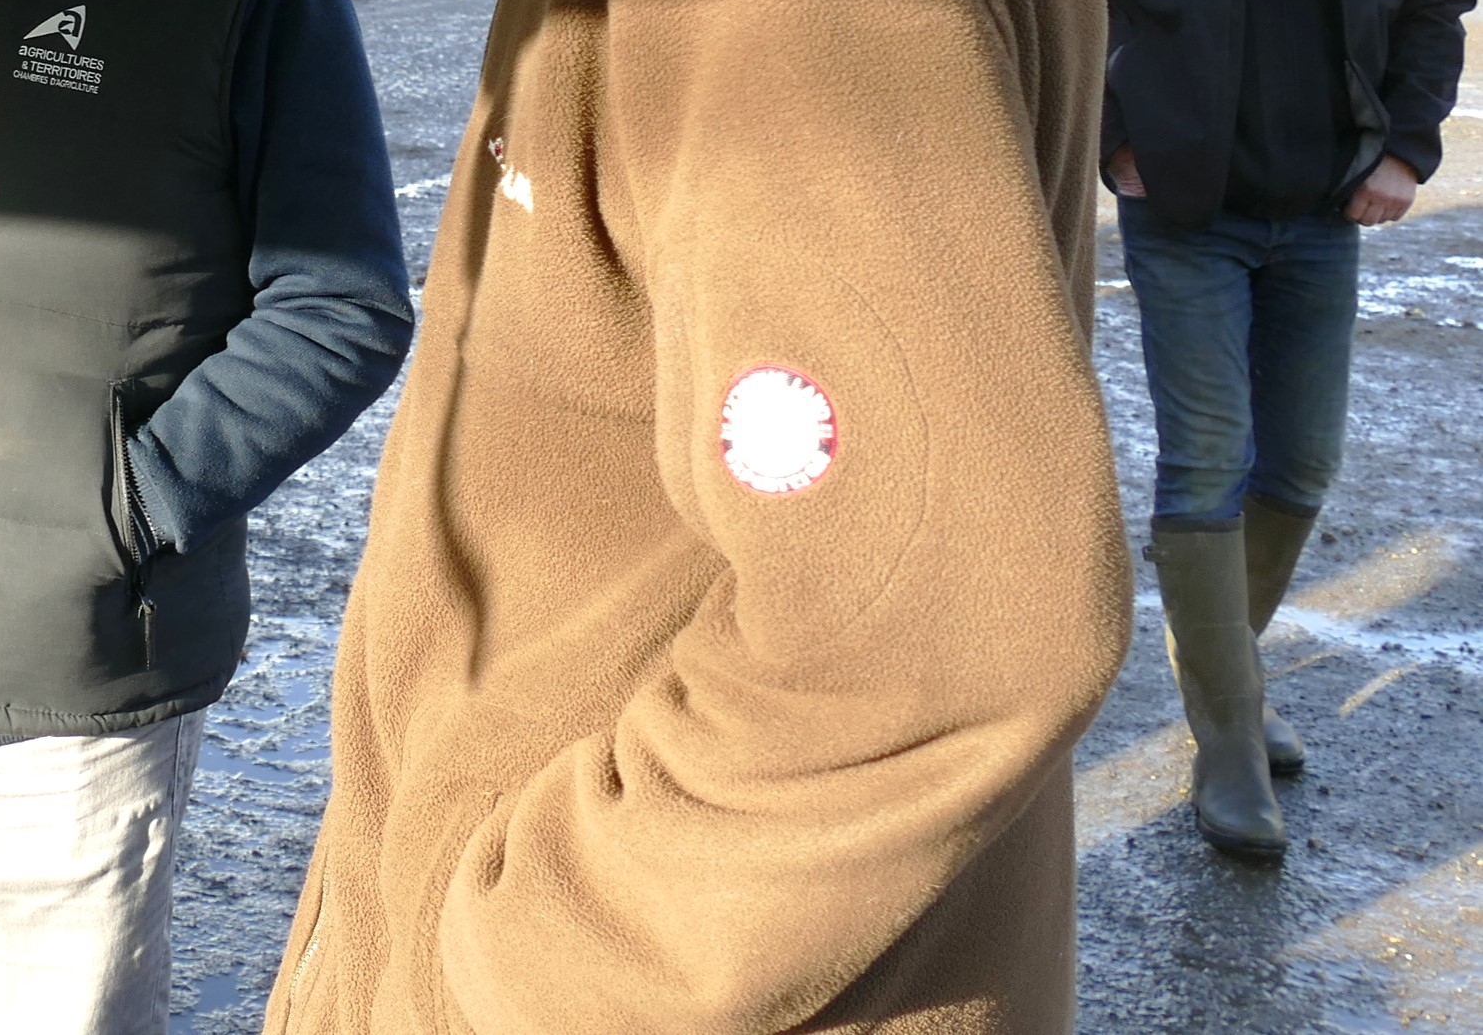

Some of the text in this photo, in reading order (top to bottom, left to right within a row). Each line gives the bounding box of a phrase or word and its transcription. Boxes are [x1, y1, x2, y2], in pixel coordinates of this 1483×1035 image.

[13, 70, 100, 94] CHAMBRES D'AGRICULTURE
[21, 60, 102, 84] & TERRITOIRES
